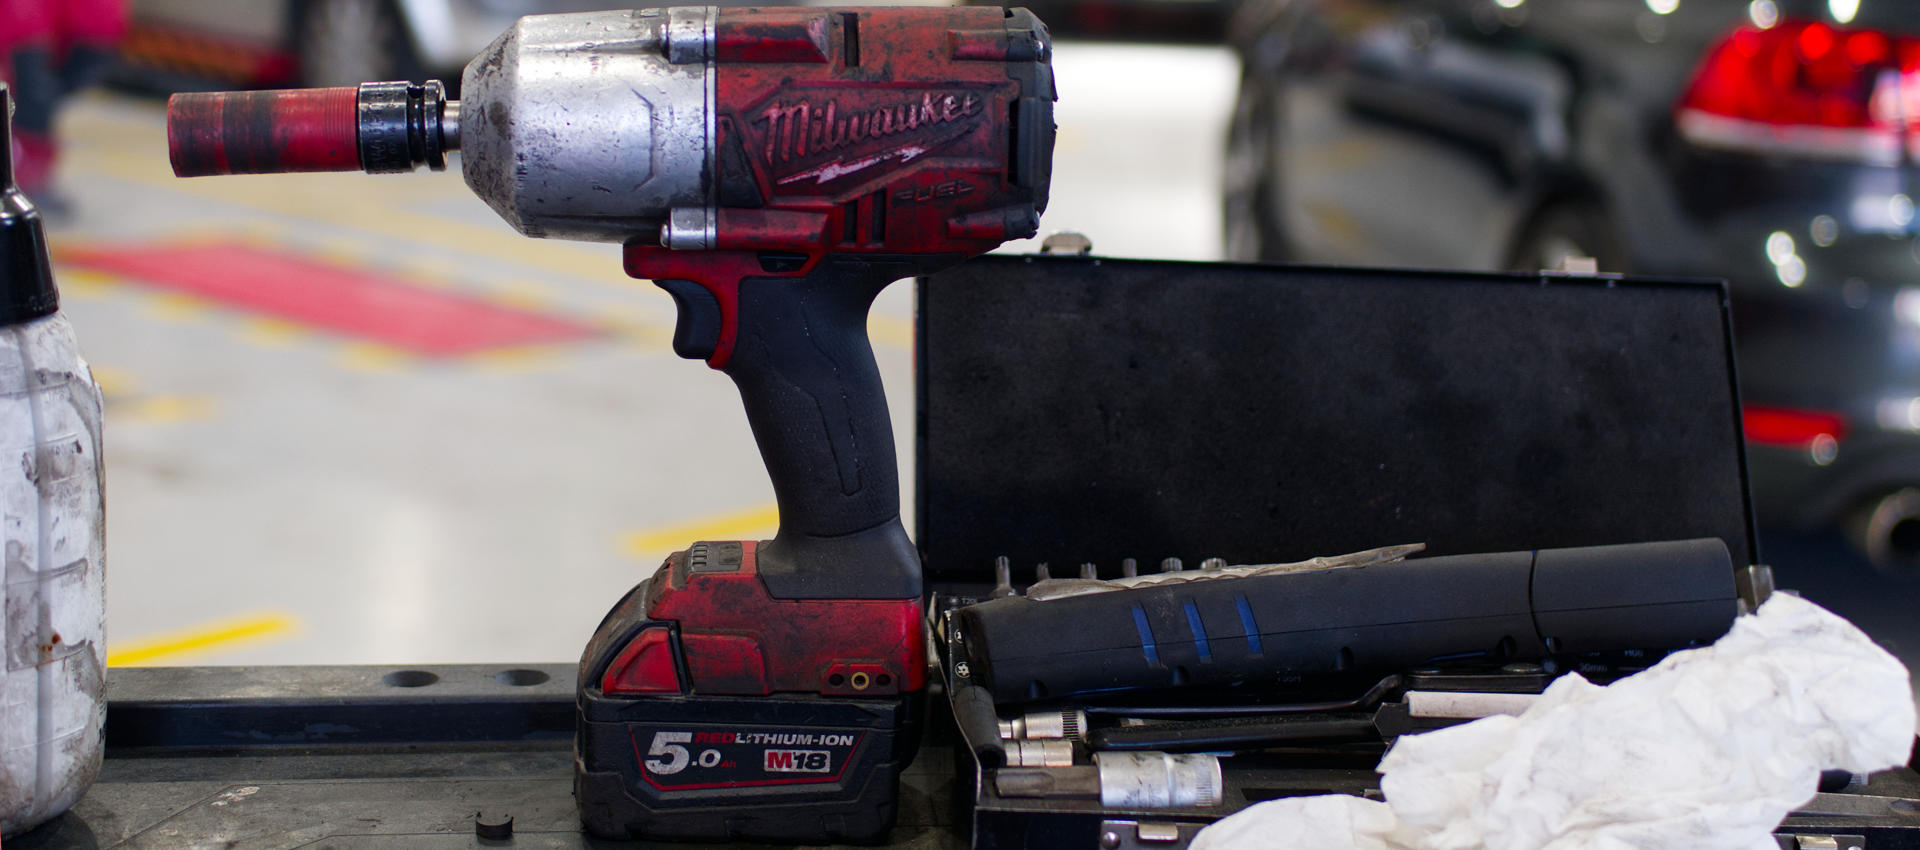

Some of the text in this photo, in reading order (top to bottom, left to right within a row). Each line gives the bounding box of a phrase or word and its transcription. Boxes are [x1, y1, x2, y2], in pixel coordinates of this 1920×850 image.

[754, 92, 985, 167] Milwaukee
[896, 180, 975, 201] FUEL
[766, 750, 829, 771] M18
